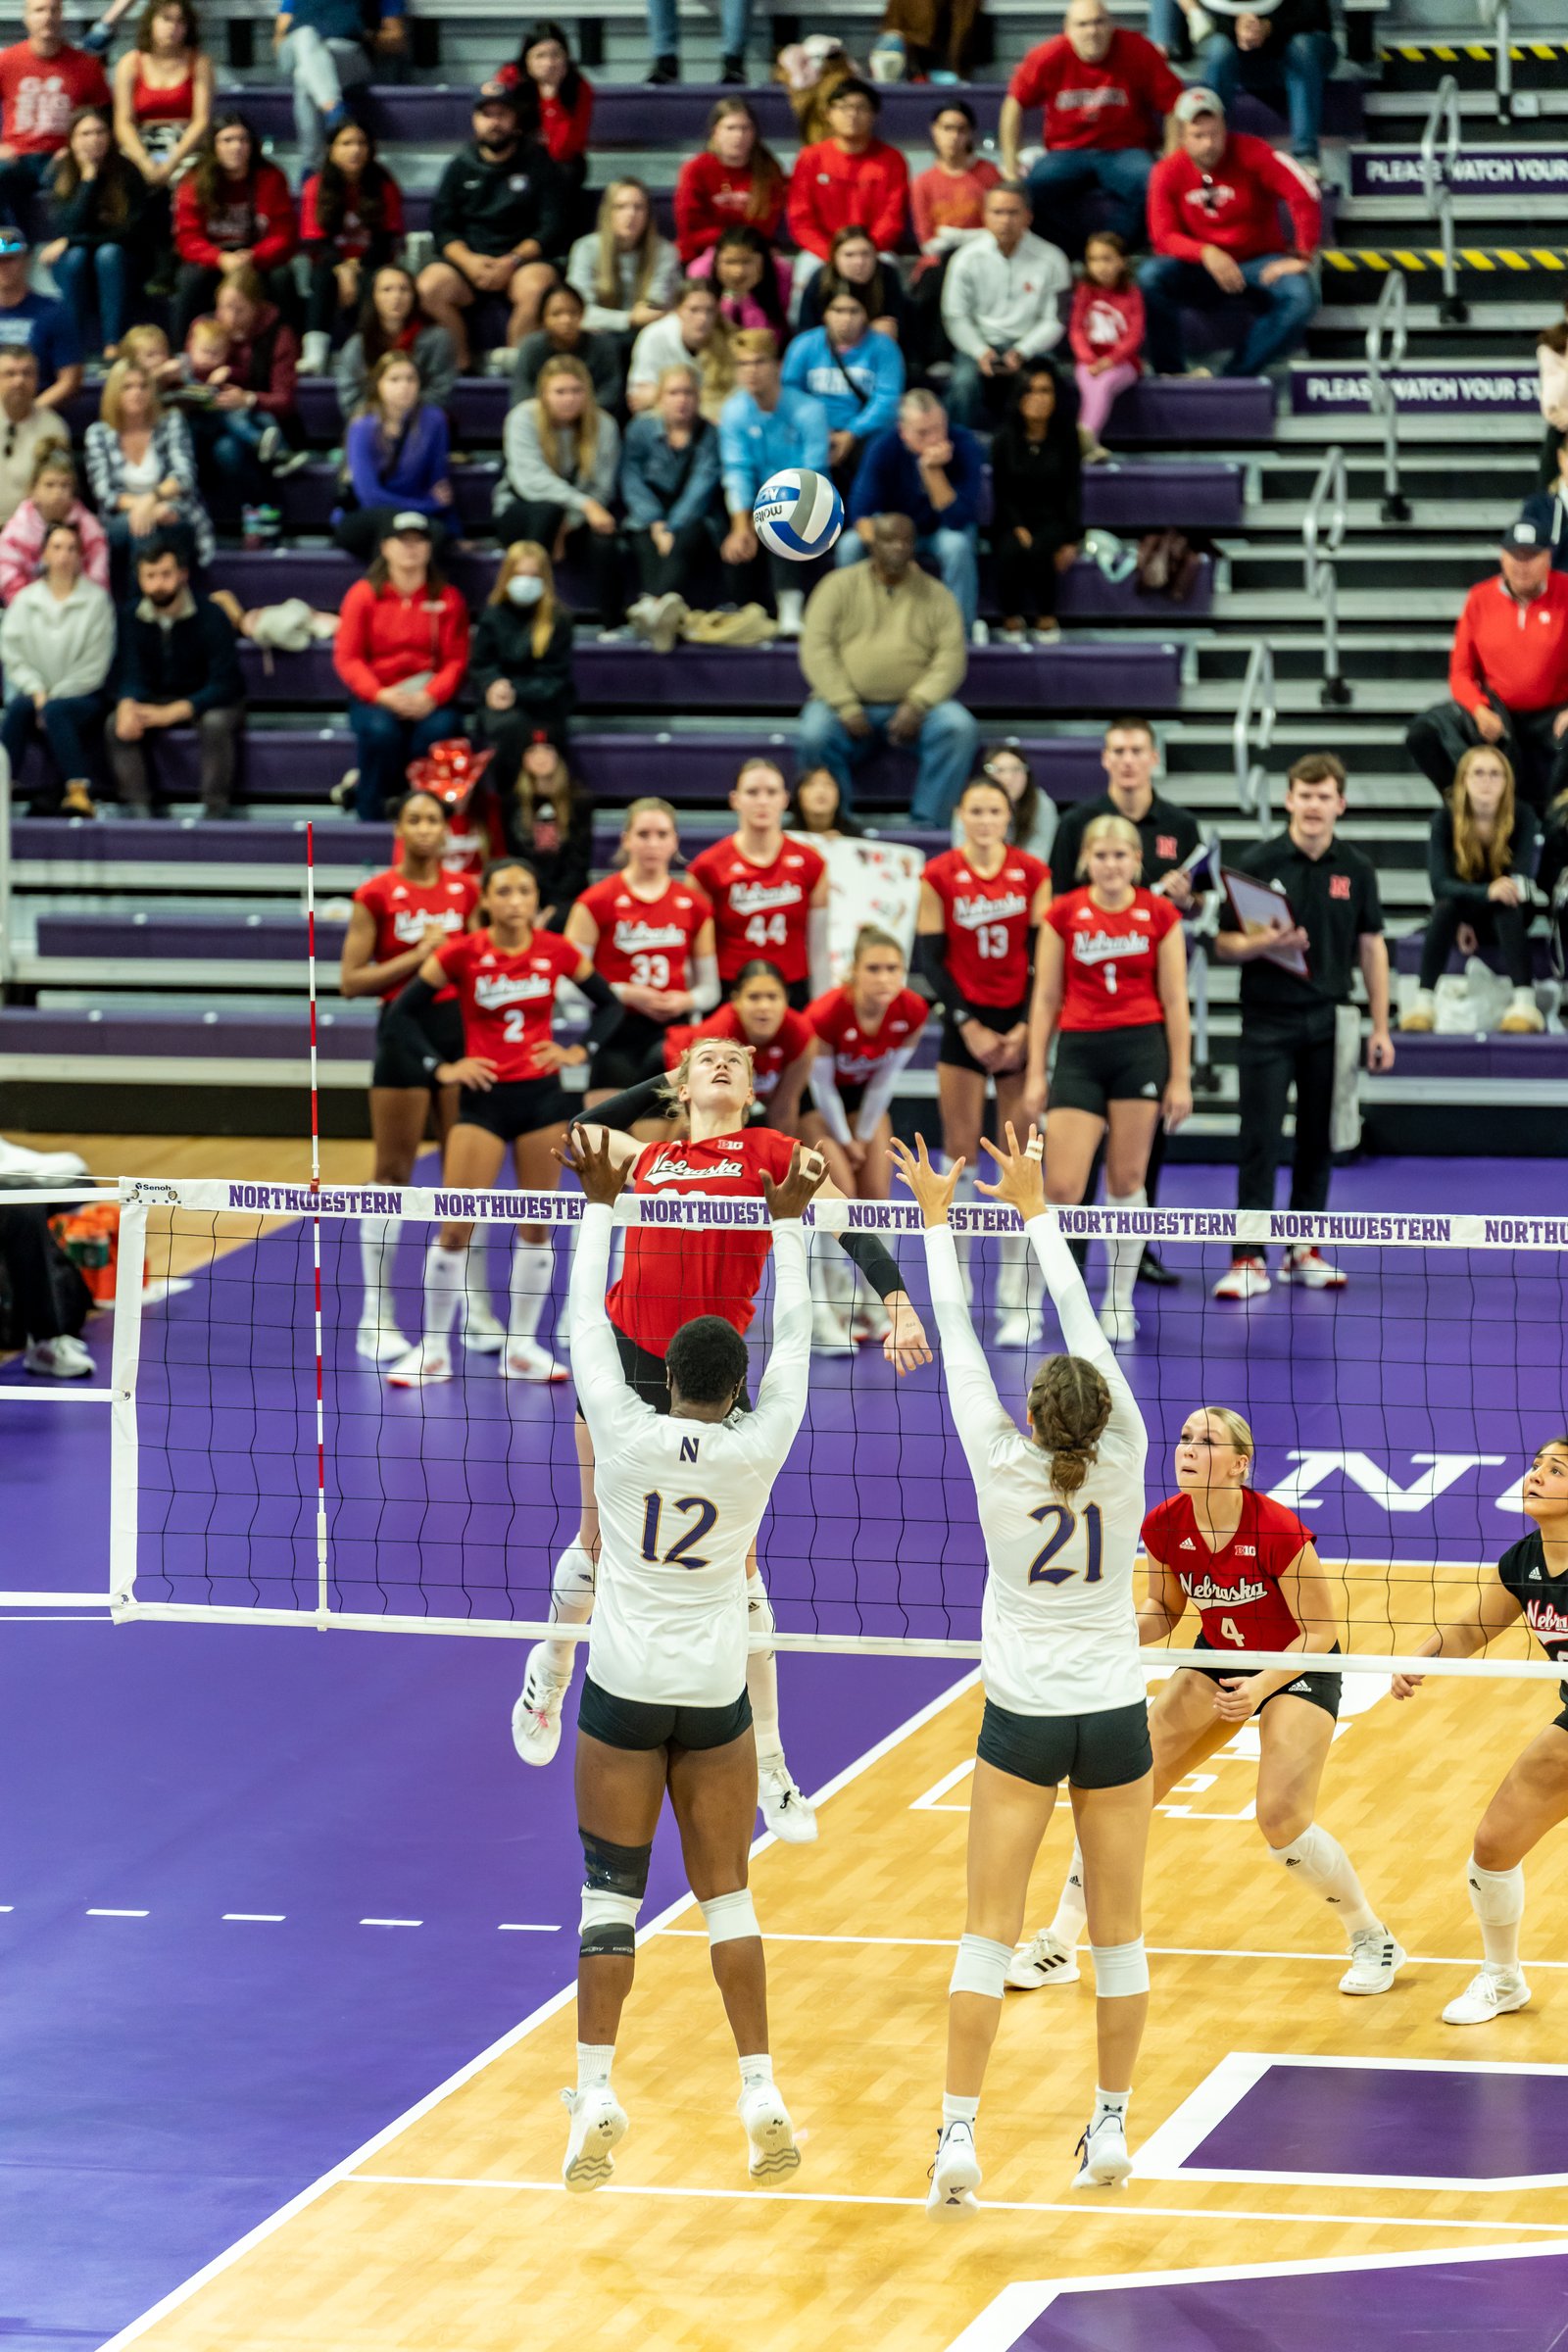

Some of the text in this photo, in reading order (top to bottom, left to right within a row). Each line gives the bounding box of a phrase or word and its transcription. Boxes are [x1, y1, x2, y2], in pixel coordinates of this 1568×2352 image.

[1306, 377, 1373, 401] PLEAS
[1458, 377, 1516, 400] YOUR
[745, 913, 787, 947] 44
[977, 925, 1008, 958] 13
[630, 954, 670, 988] 33
[1102, 962, 1117, 996] 1
[504, 1008, 525, 1043] 2
[229, 1185, 402, 1214] NORTHWESTERN
[434, 1194, 587, 1219] NORTHWESTE
[640, 1200, 815, 1226] NORTHWESTN
[848, 1205, 1025, 1232] NORTHESTERN
[1058, 1210, 1237, 1236] NORTHWESTERN
[1270, 1214, 1450, 1242] NORTHWESTERN
[679, 1436, 700, 1463] N
[640, 1489, 719, 1570] 12
[1027, 1500, 1103, 1586] 21
[1179, 1573, 1268, 1605] Nebraska
[1220, 1617, 1245, 1647] 4
